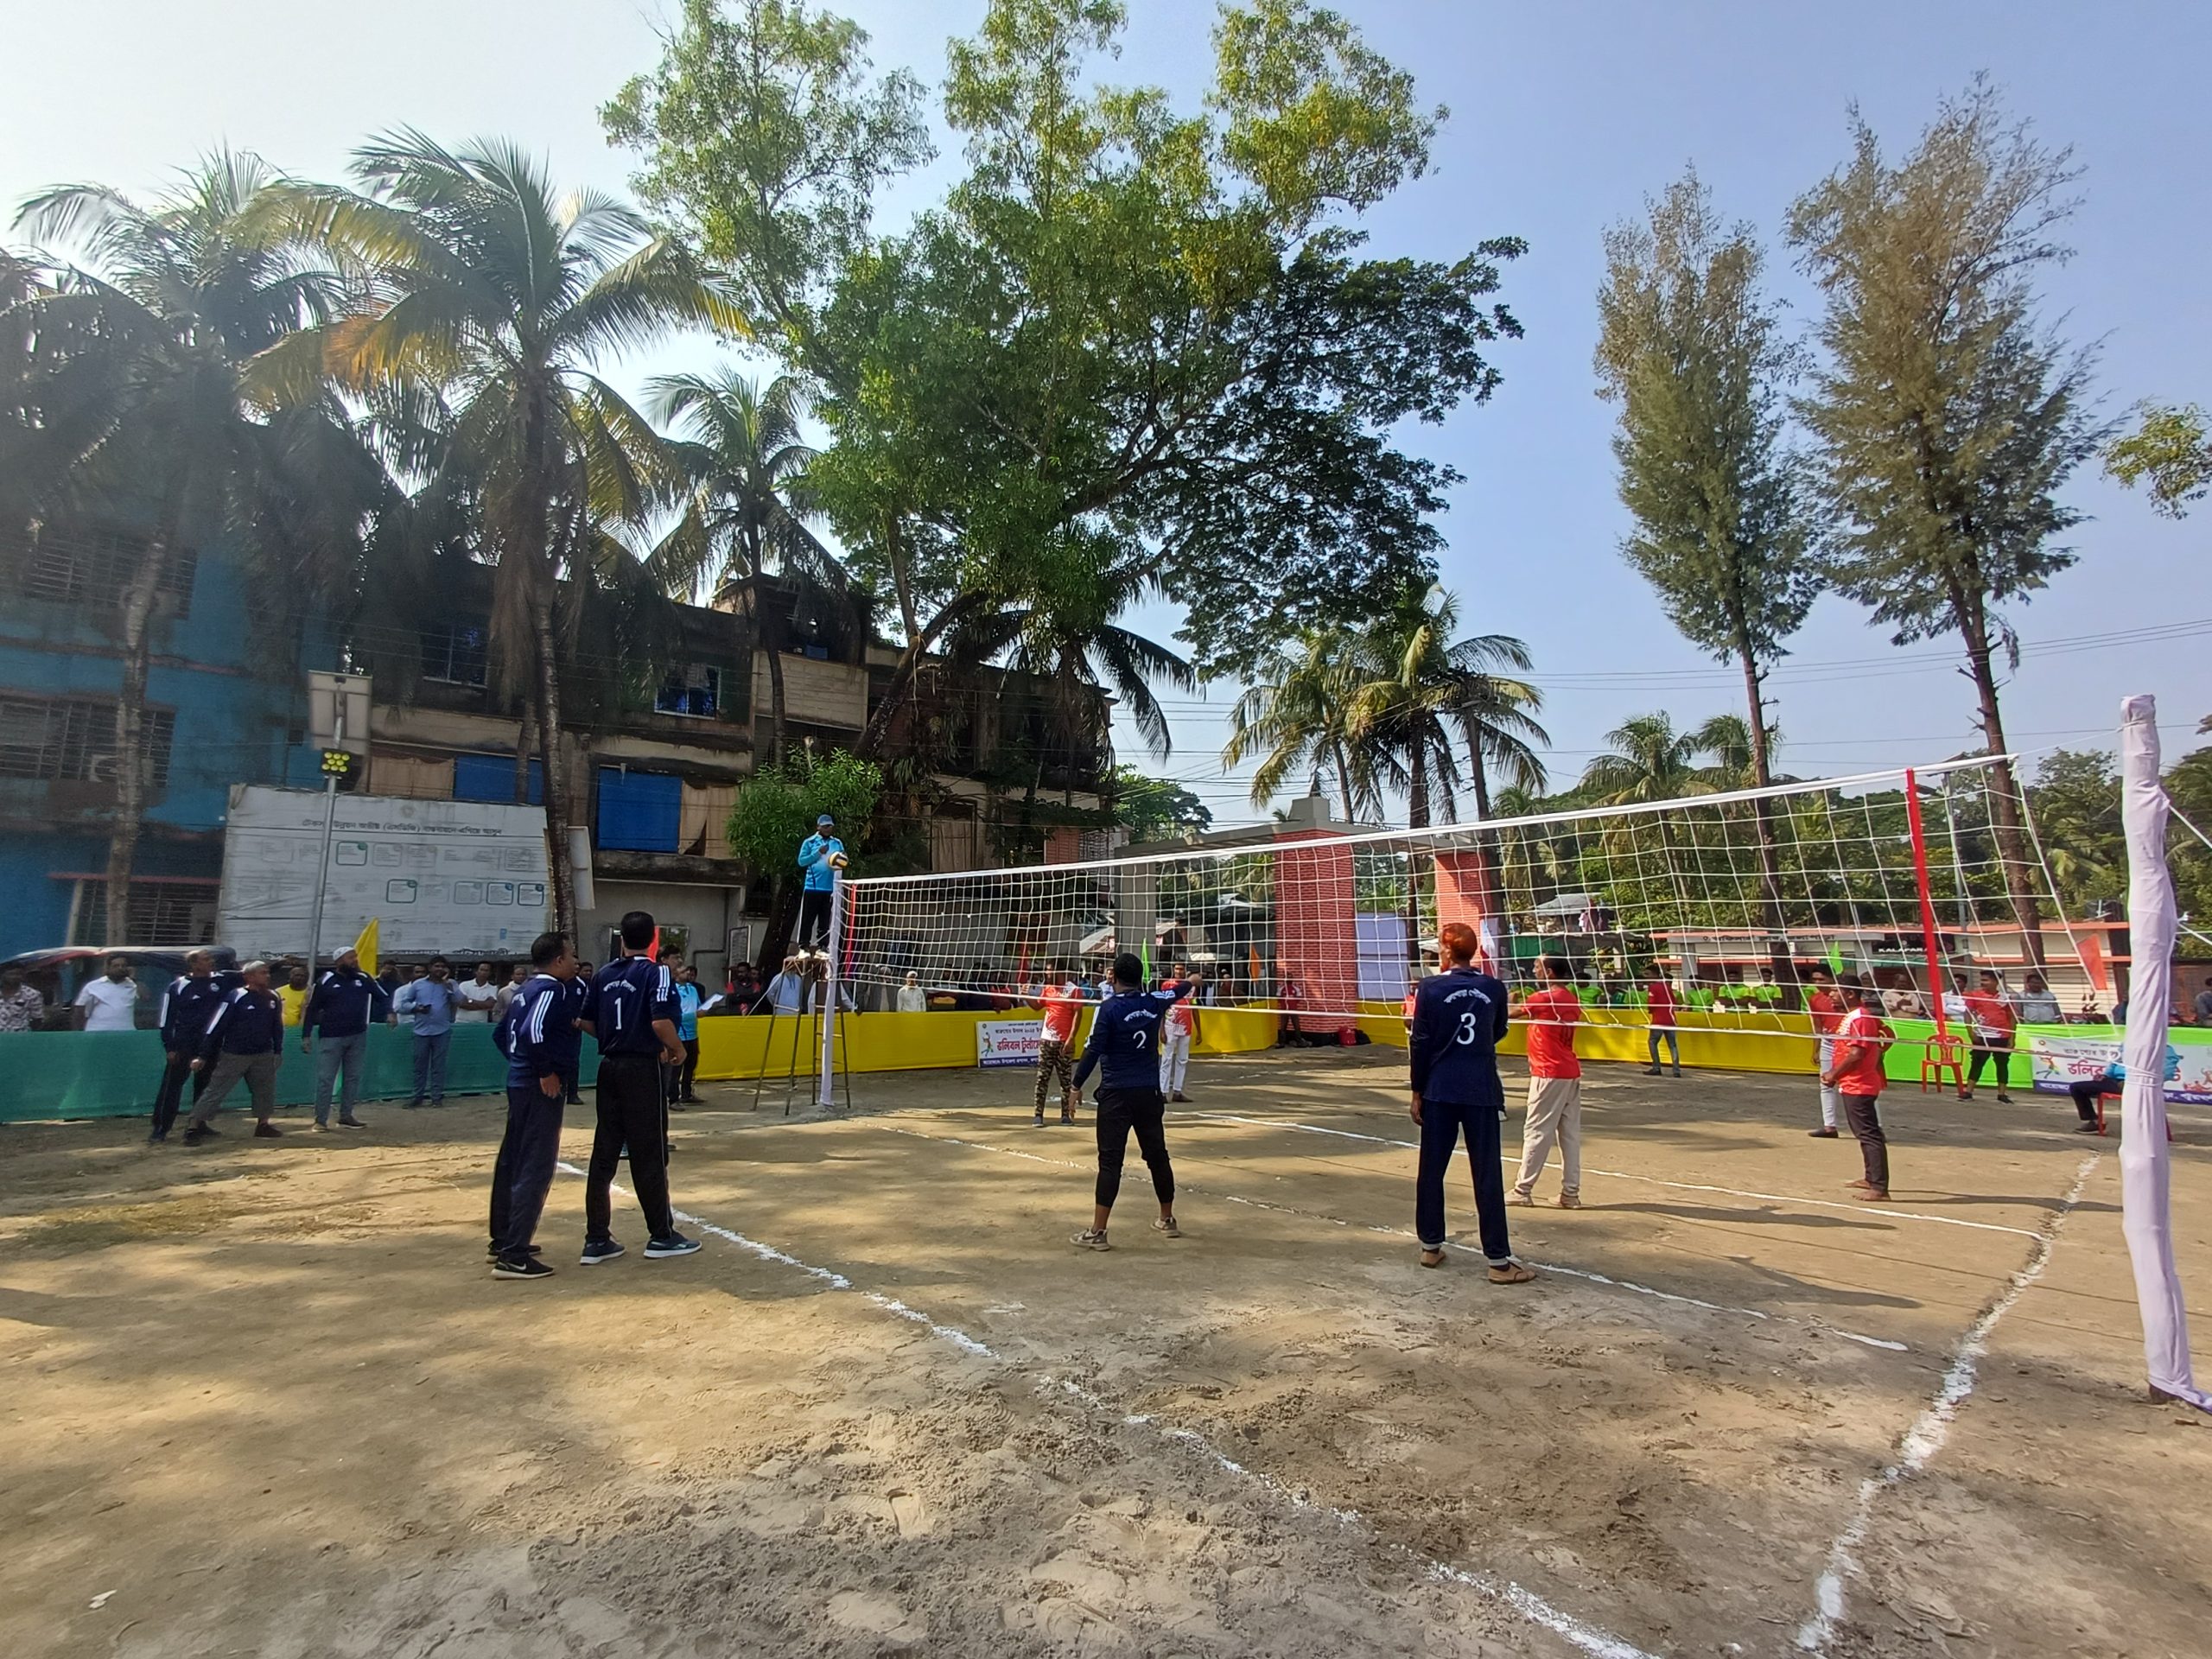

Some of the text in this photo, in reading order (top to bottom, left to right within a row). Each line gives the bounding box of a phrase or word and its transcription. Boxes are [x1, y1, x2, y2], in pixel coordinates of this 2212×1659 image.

[614, 997, 622, 1030] 1
[1133, 1030, 1147, 1049] 2
[1456, 1012, 1477, 1046] 3
[996, 1037, 1020, 1052] ভলিবল
